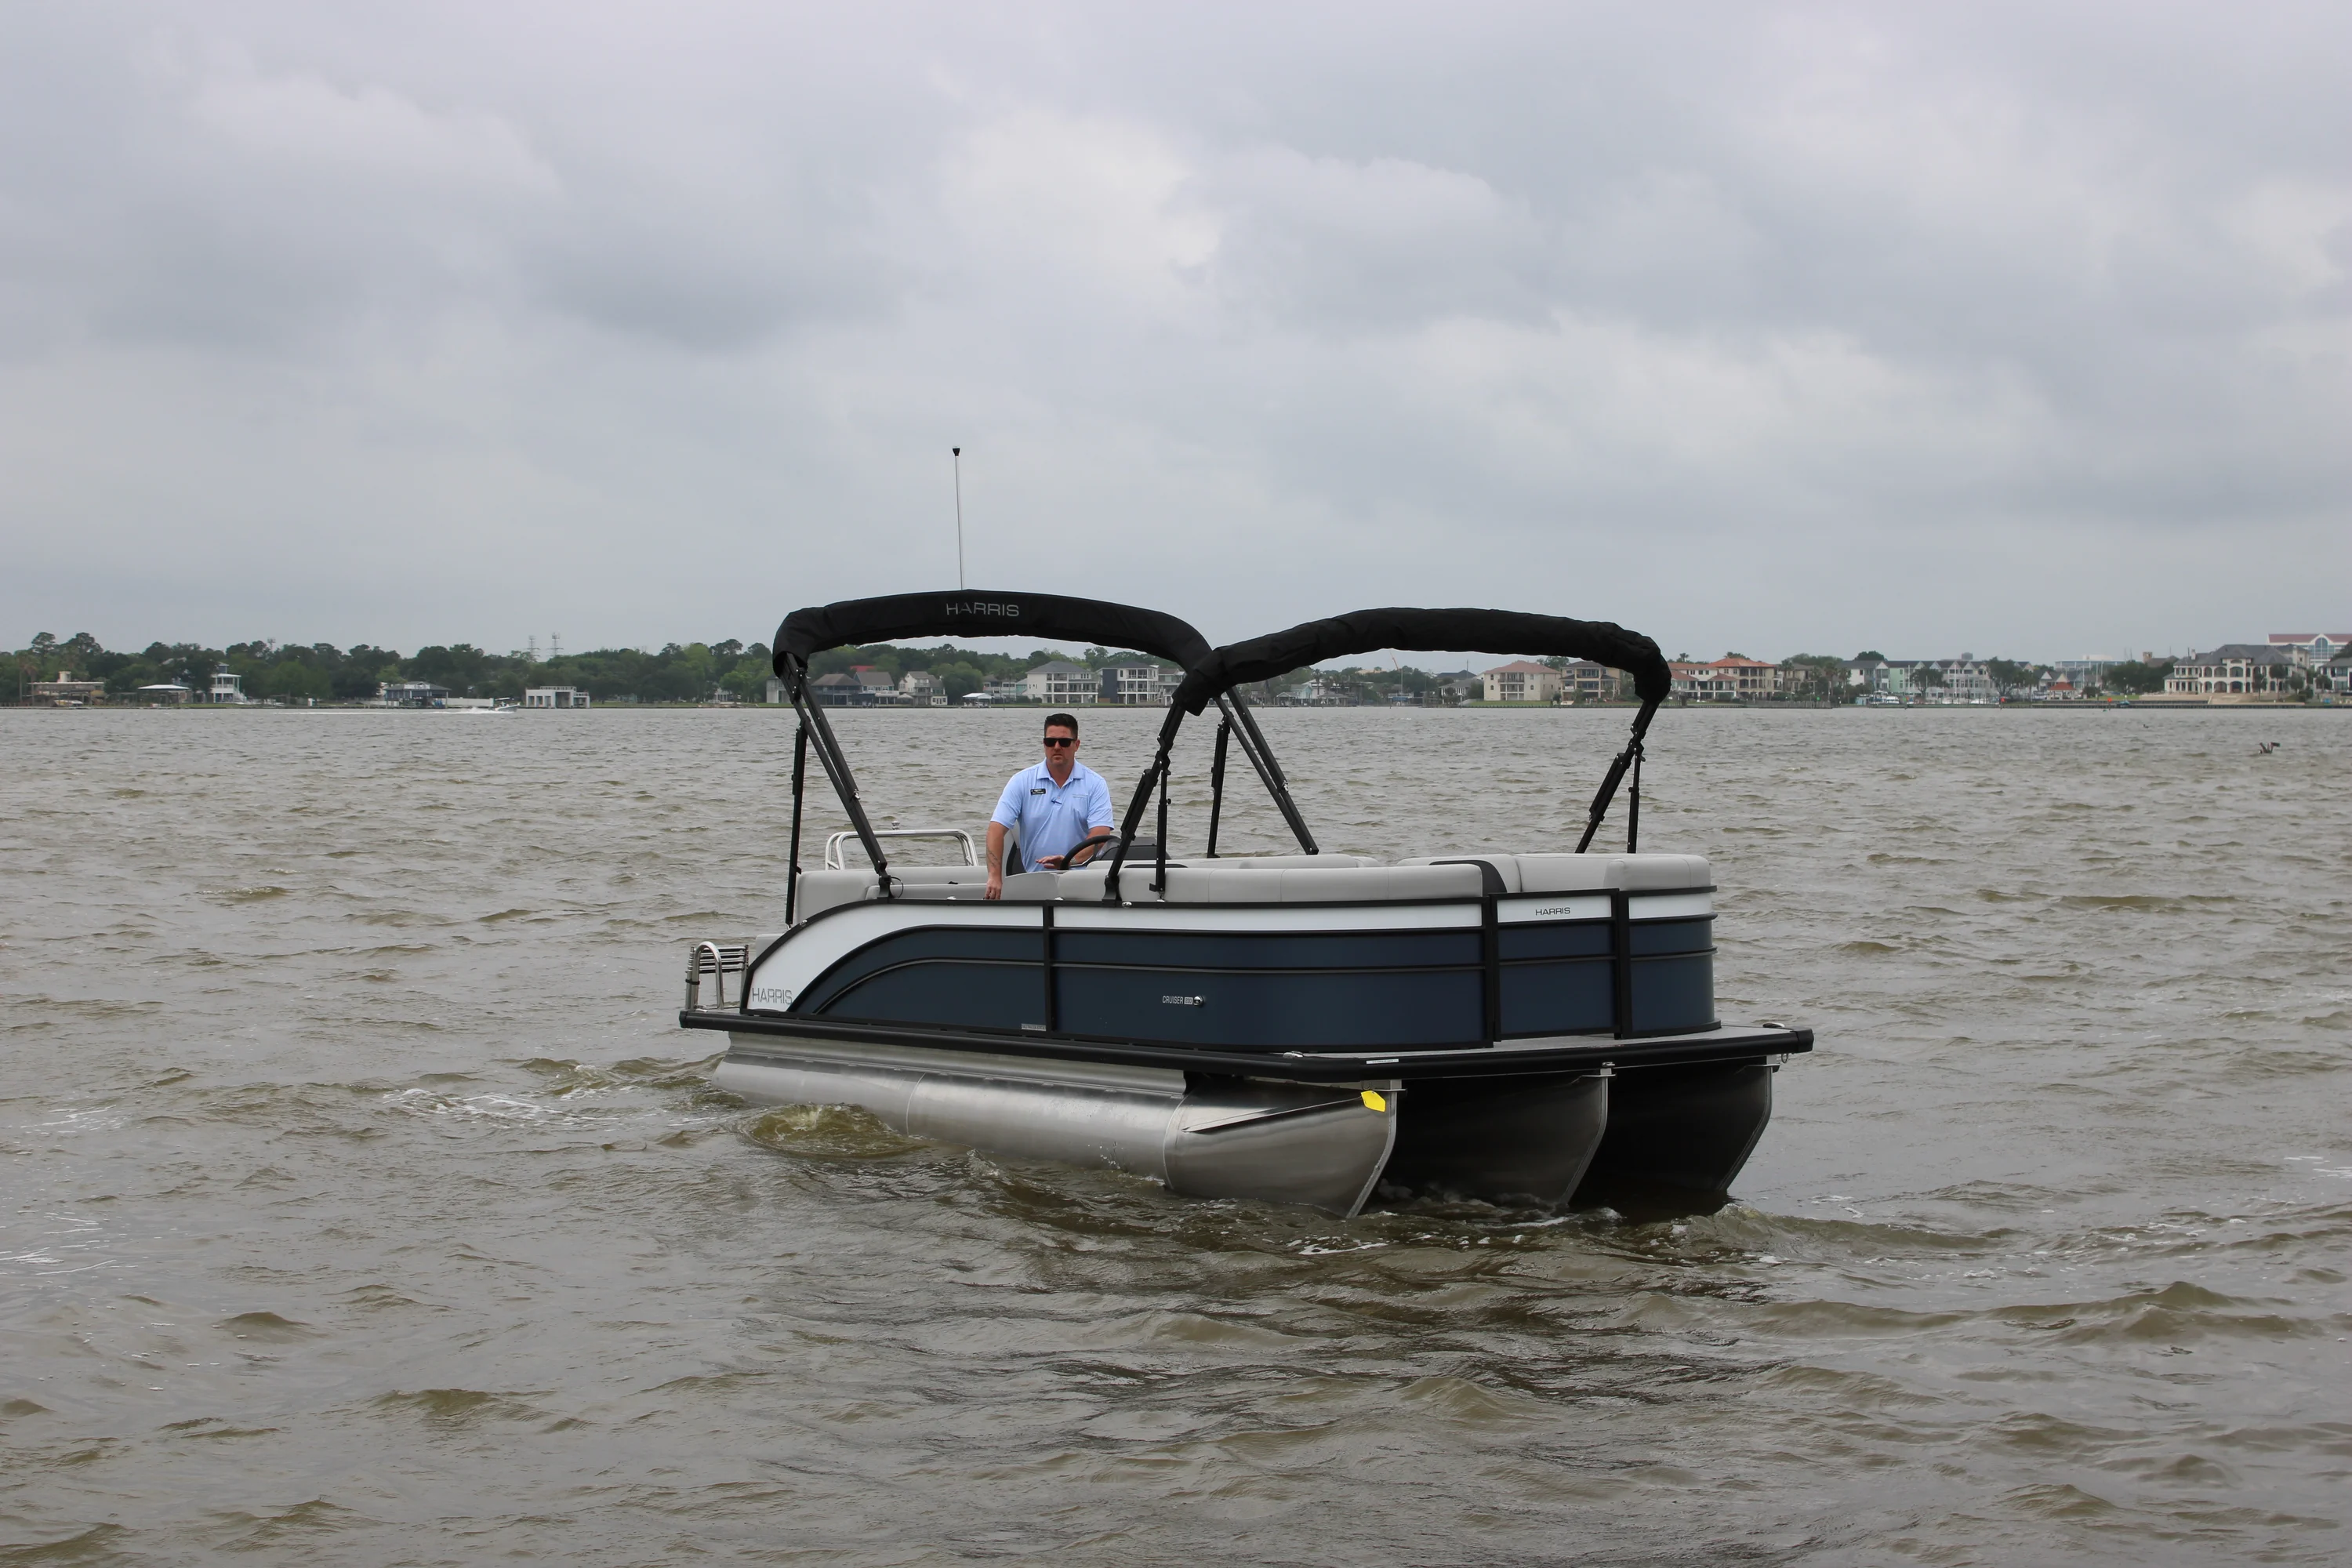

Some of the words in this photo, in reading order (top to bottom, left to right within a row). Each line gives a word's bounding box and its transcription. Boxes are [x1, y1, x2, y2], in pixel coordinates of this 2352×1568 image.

[946, 602, 1019, 617] HARRIS
[1535, 907, 1571, 916] HARRIS
[752, 987, 793, 1004] HARRIS
[1162, 995, 1184, 1004] CRUISER
